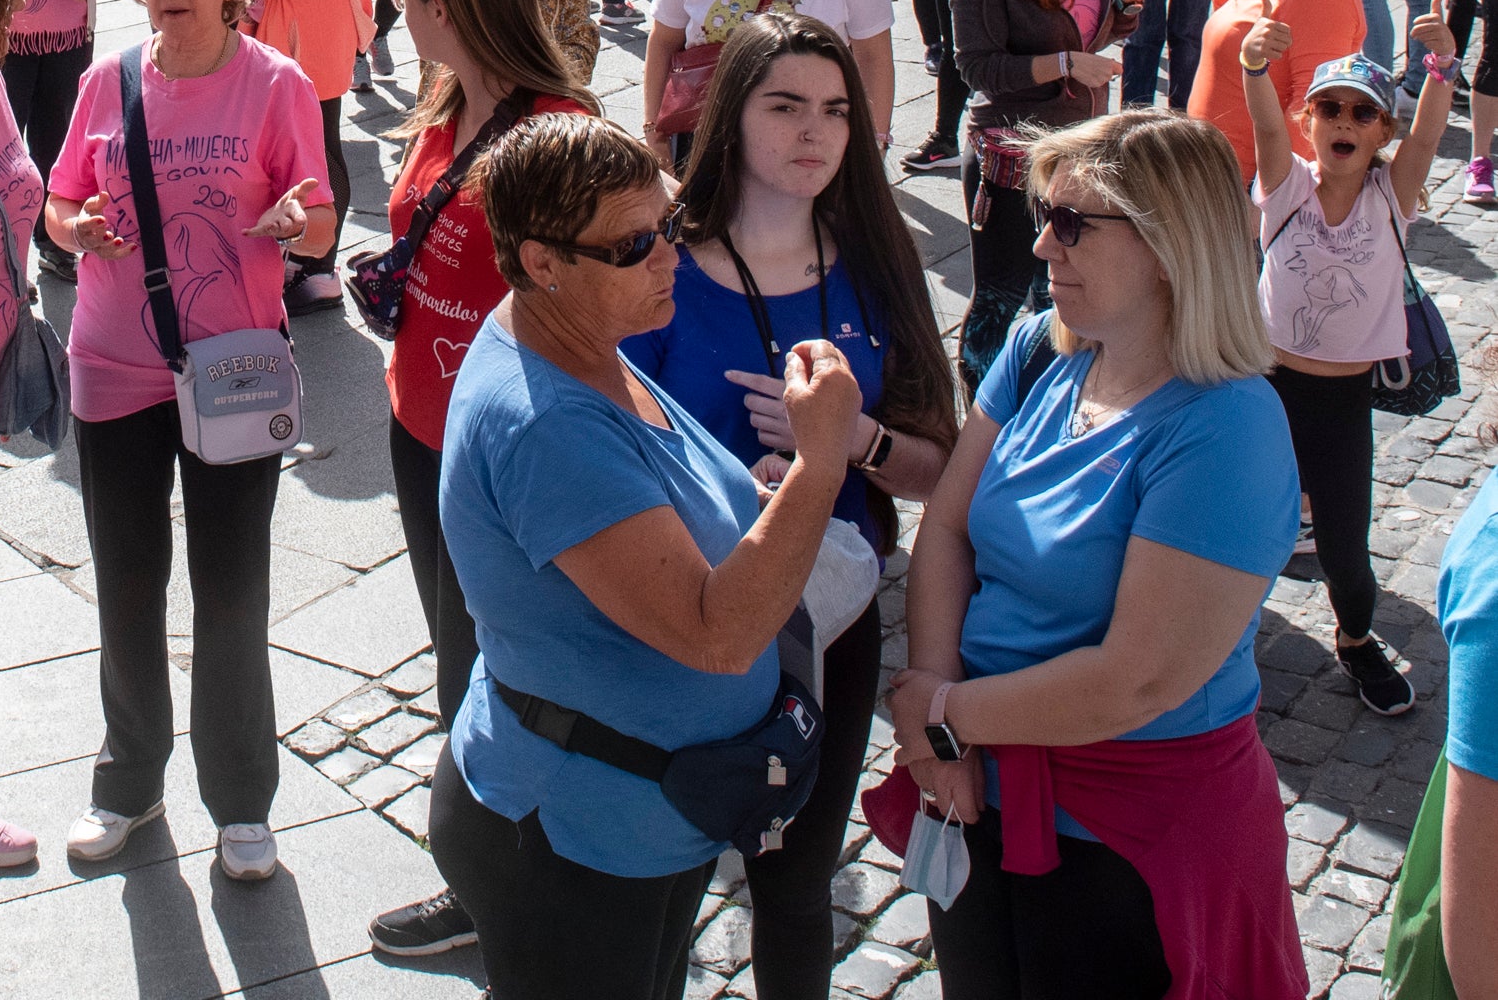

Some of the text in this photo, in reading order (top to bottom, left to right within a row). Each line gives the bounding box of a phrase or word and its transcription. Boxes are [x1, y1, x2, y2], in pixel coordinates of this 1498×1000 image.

[184, 135, 249, 164] MUJERES
[193, 185, 237, 218] 2019
[429, 224, 462, 253] ujeres
[454, 223, 468, 238] de
[435, 249, 460, 270] 2012
[405, 280, 479, 322] compartidos
[206, 353, 281, 383] REEBOK
[214, 389, 279, 406] OUTPERFORM
